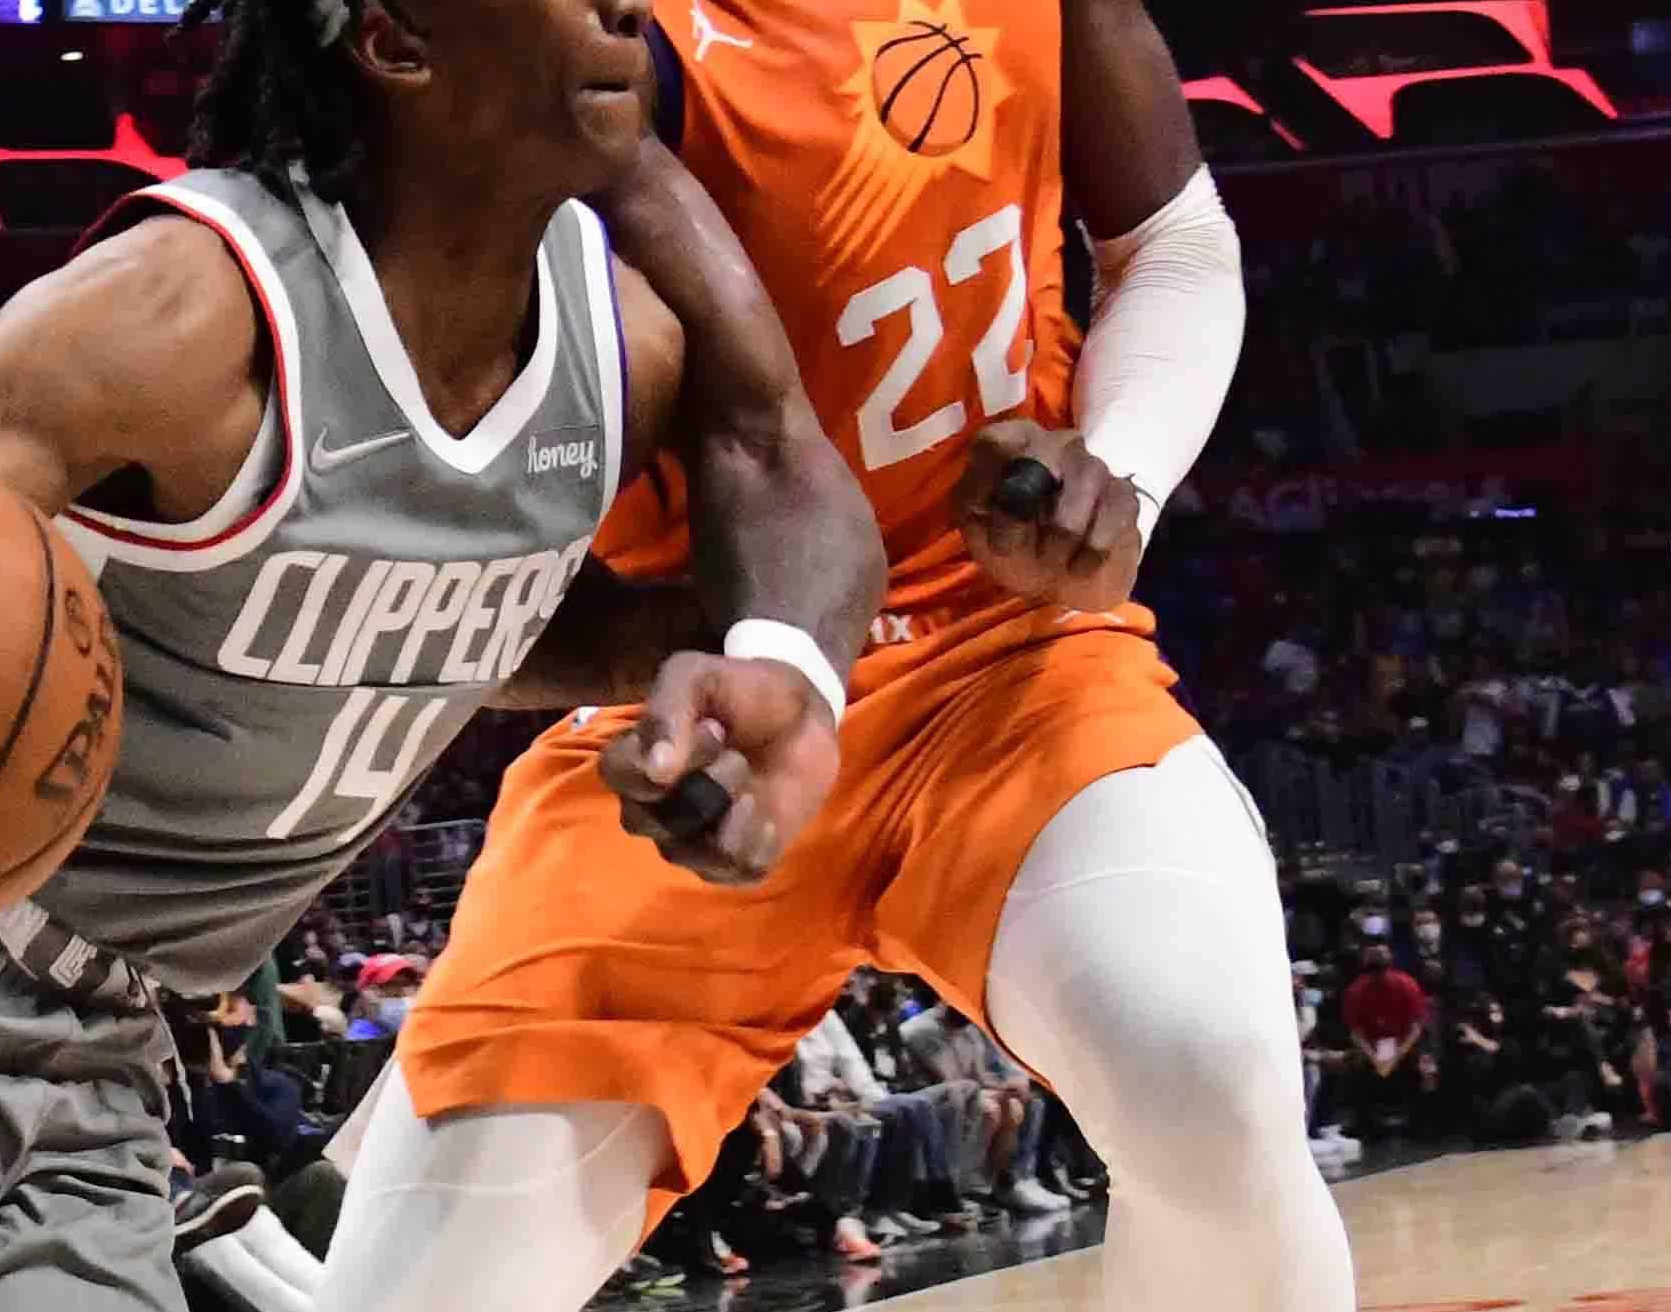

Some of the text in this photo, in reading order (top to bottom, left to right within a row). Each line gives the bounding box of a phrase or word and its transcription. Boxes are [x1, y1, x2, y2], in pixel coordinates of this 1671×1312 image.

[835, 203, 1034, 472] 22
[525, 434, 599, 479] honey
[266, 687, 448, 843] 14
